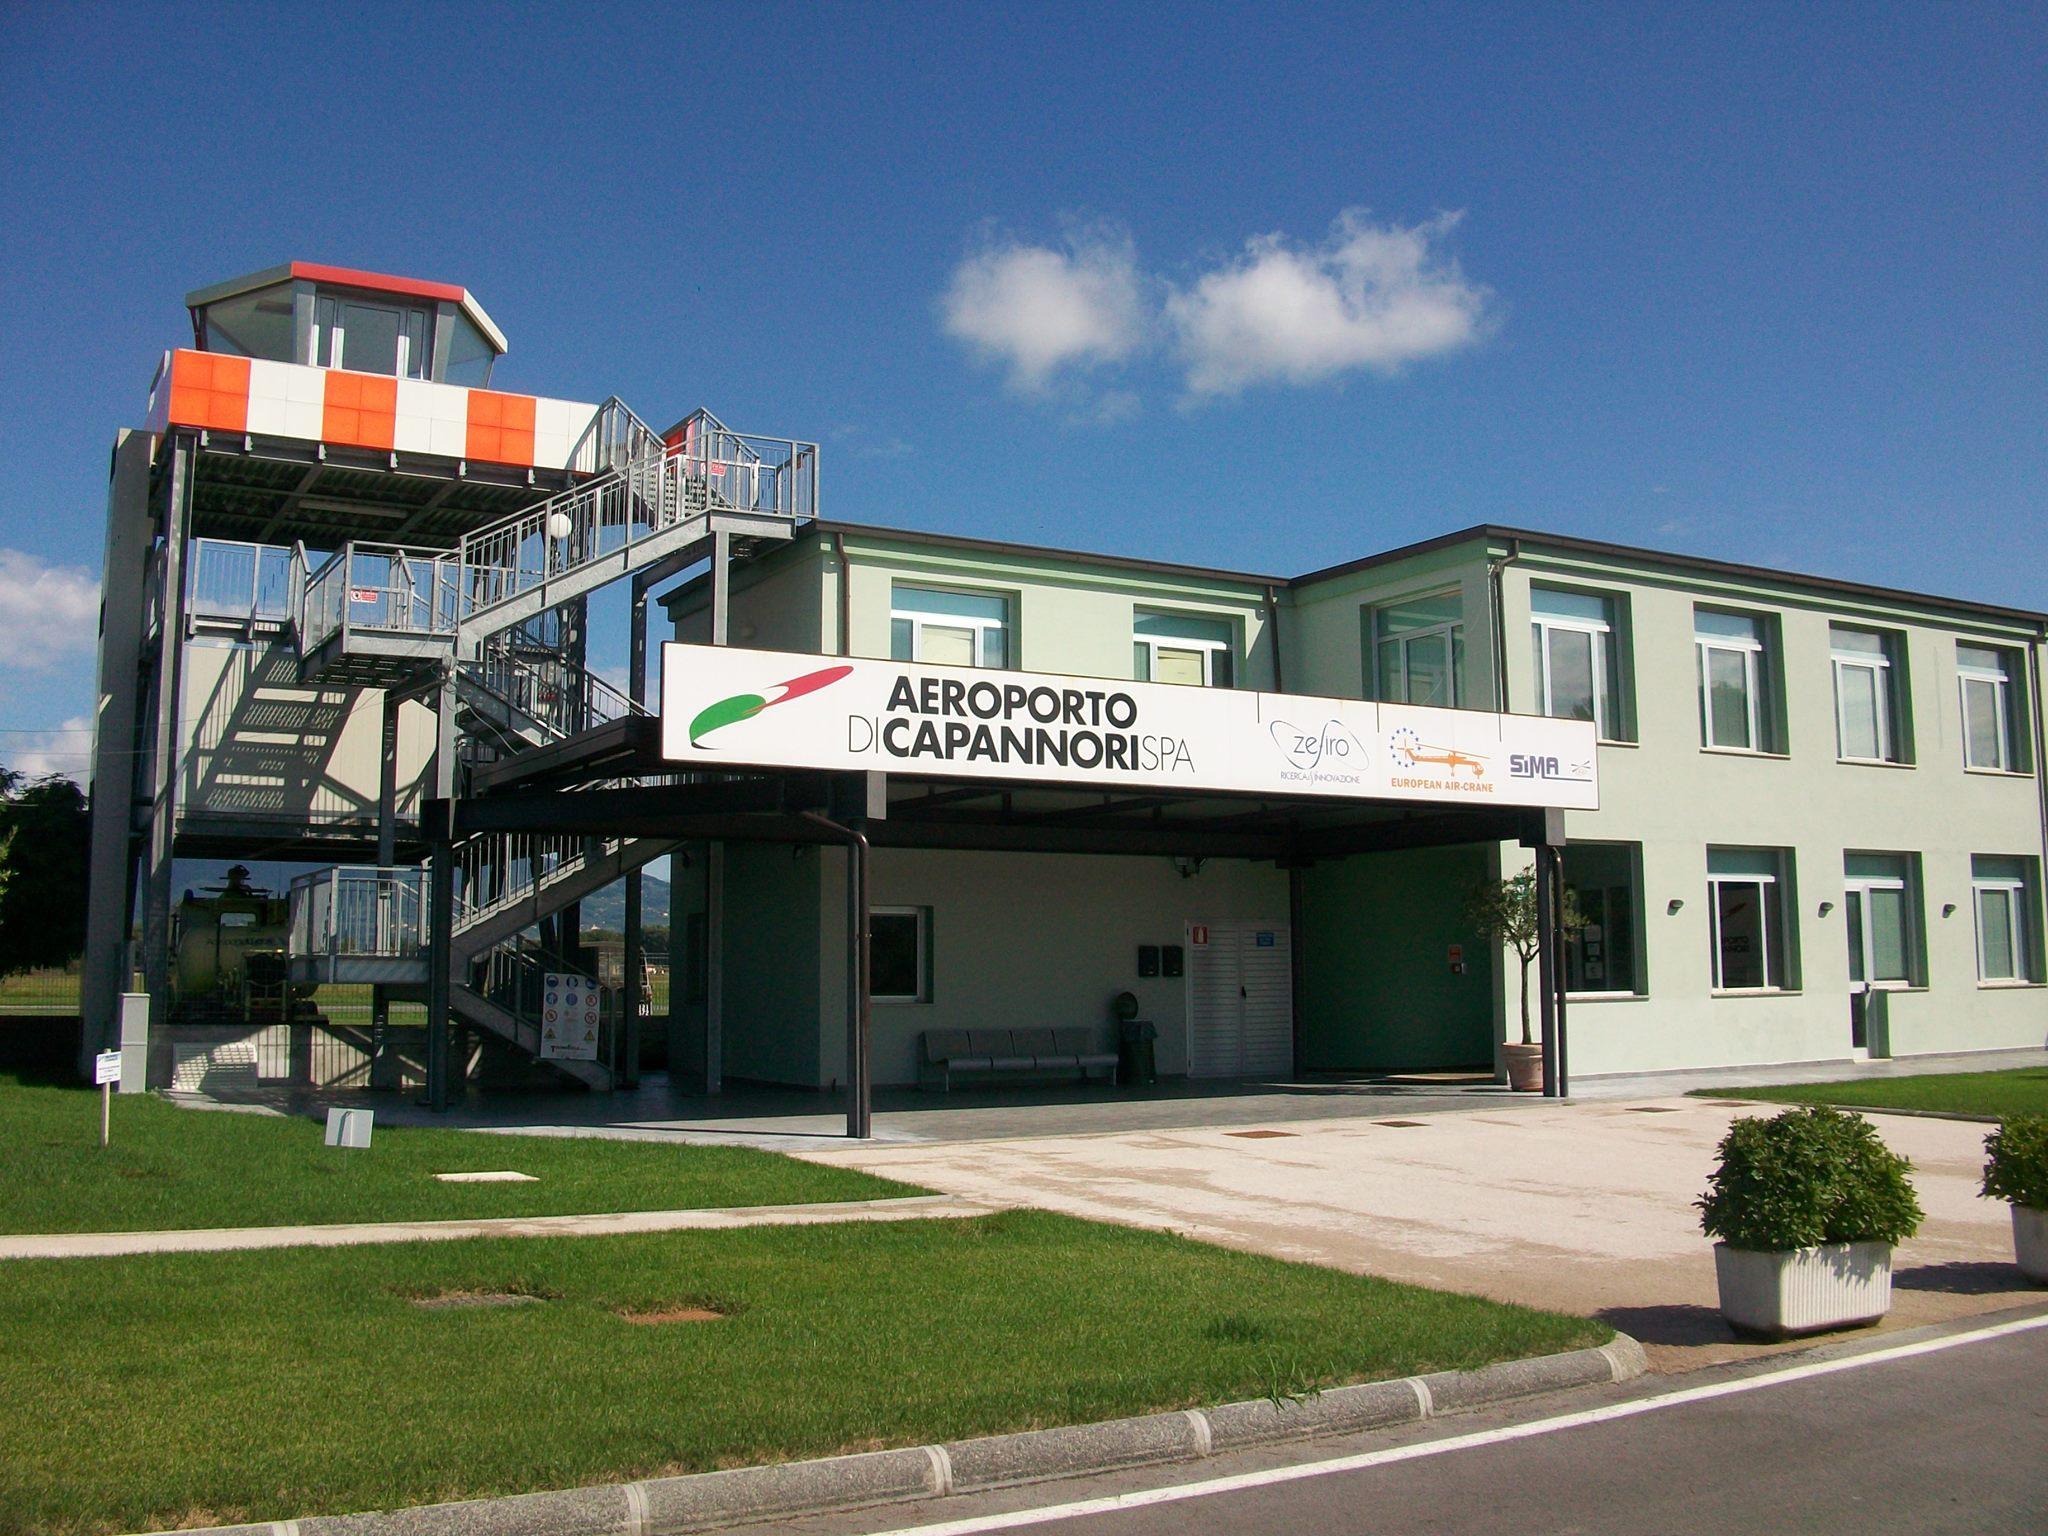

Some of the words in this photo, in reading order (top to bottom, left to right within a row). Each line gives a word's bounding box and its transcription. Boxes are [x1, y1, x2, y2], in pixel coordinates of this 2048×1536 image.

[886, 675, 1137, 729] AEROPORTO
[1391, 777, 1442, 790] EUROPEAN
[1445, 780, 1494, 793] AIR-CRANE
